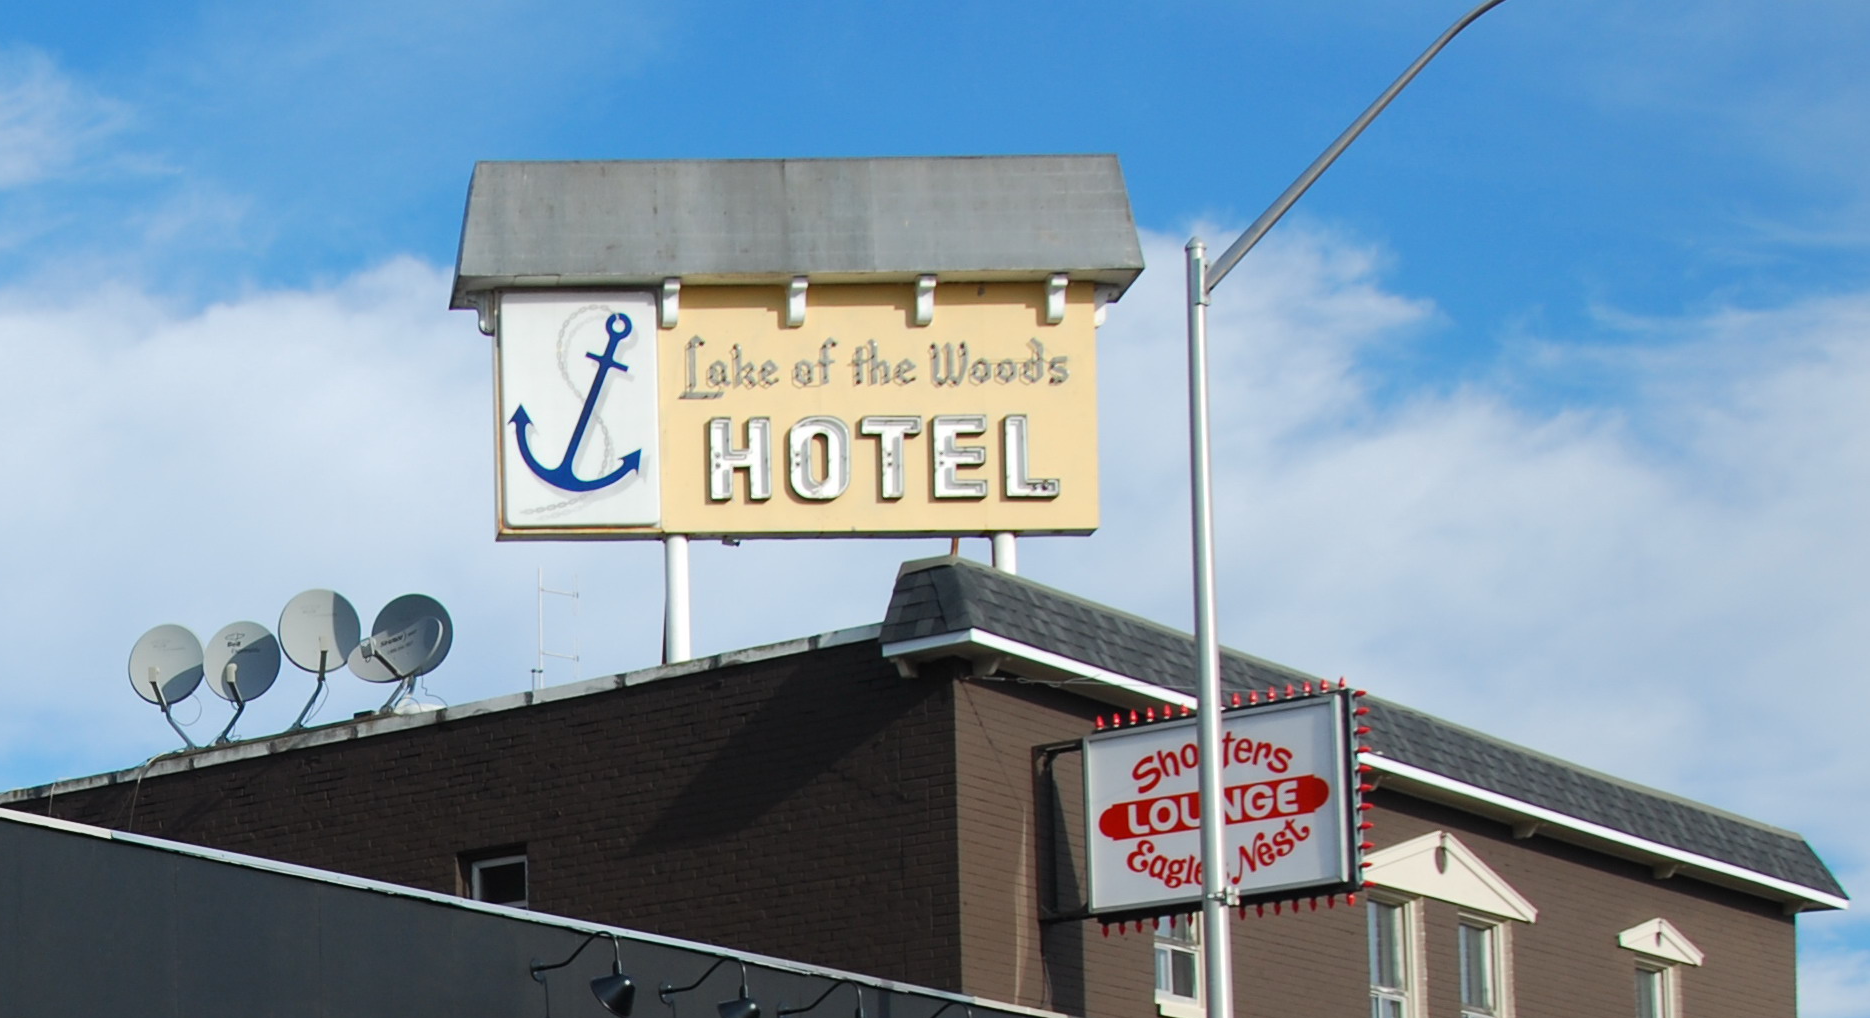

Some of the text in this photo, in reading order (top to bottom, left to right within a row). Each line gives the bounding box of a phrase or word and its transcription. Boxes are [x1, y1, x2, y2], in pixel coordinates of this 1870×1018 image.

[679, 334, 1070, 399] Lake of the Woods
[705, 413, 1061, 502] HOTEL
[1132, 731, 1293, 794] Shoters
[1126, 818, 1311, 889] Eagle Nest
